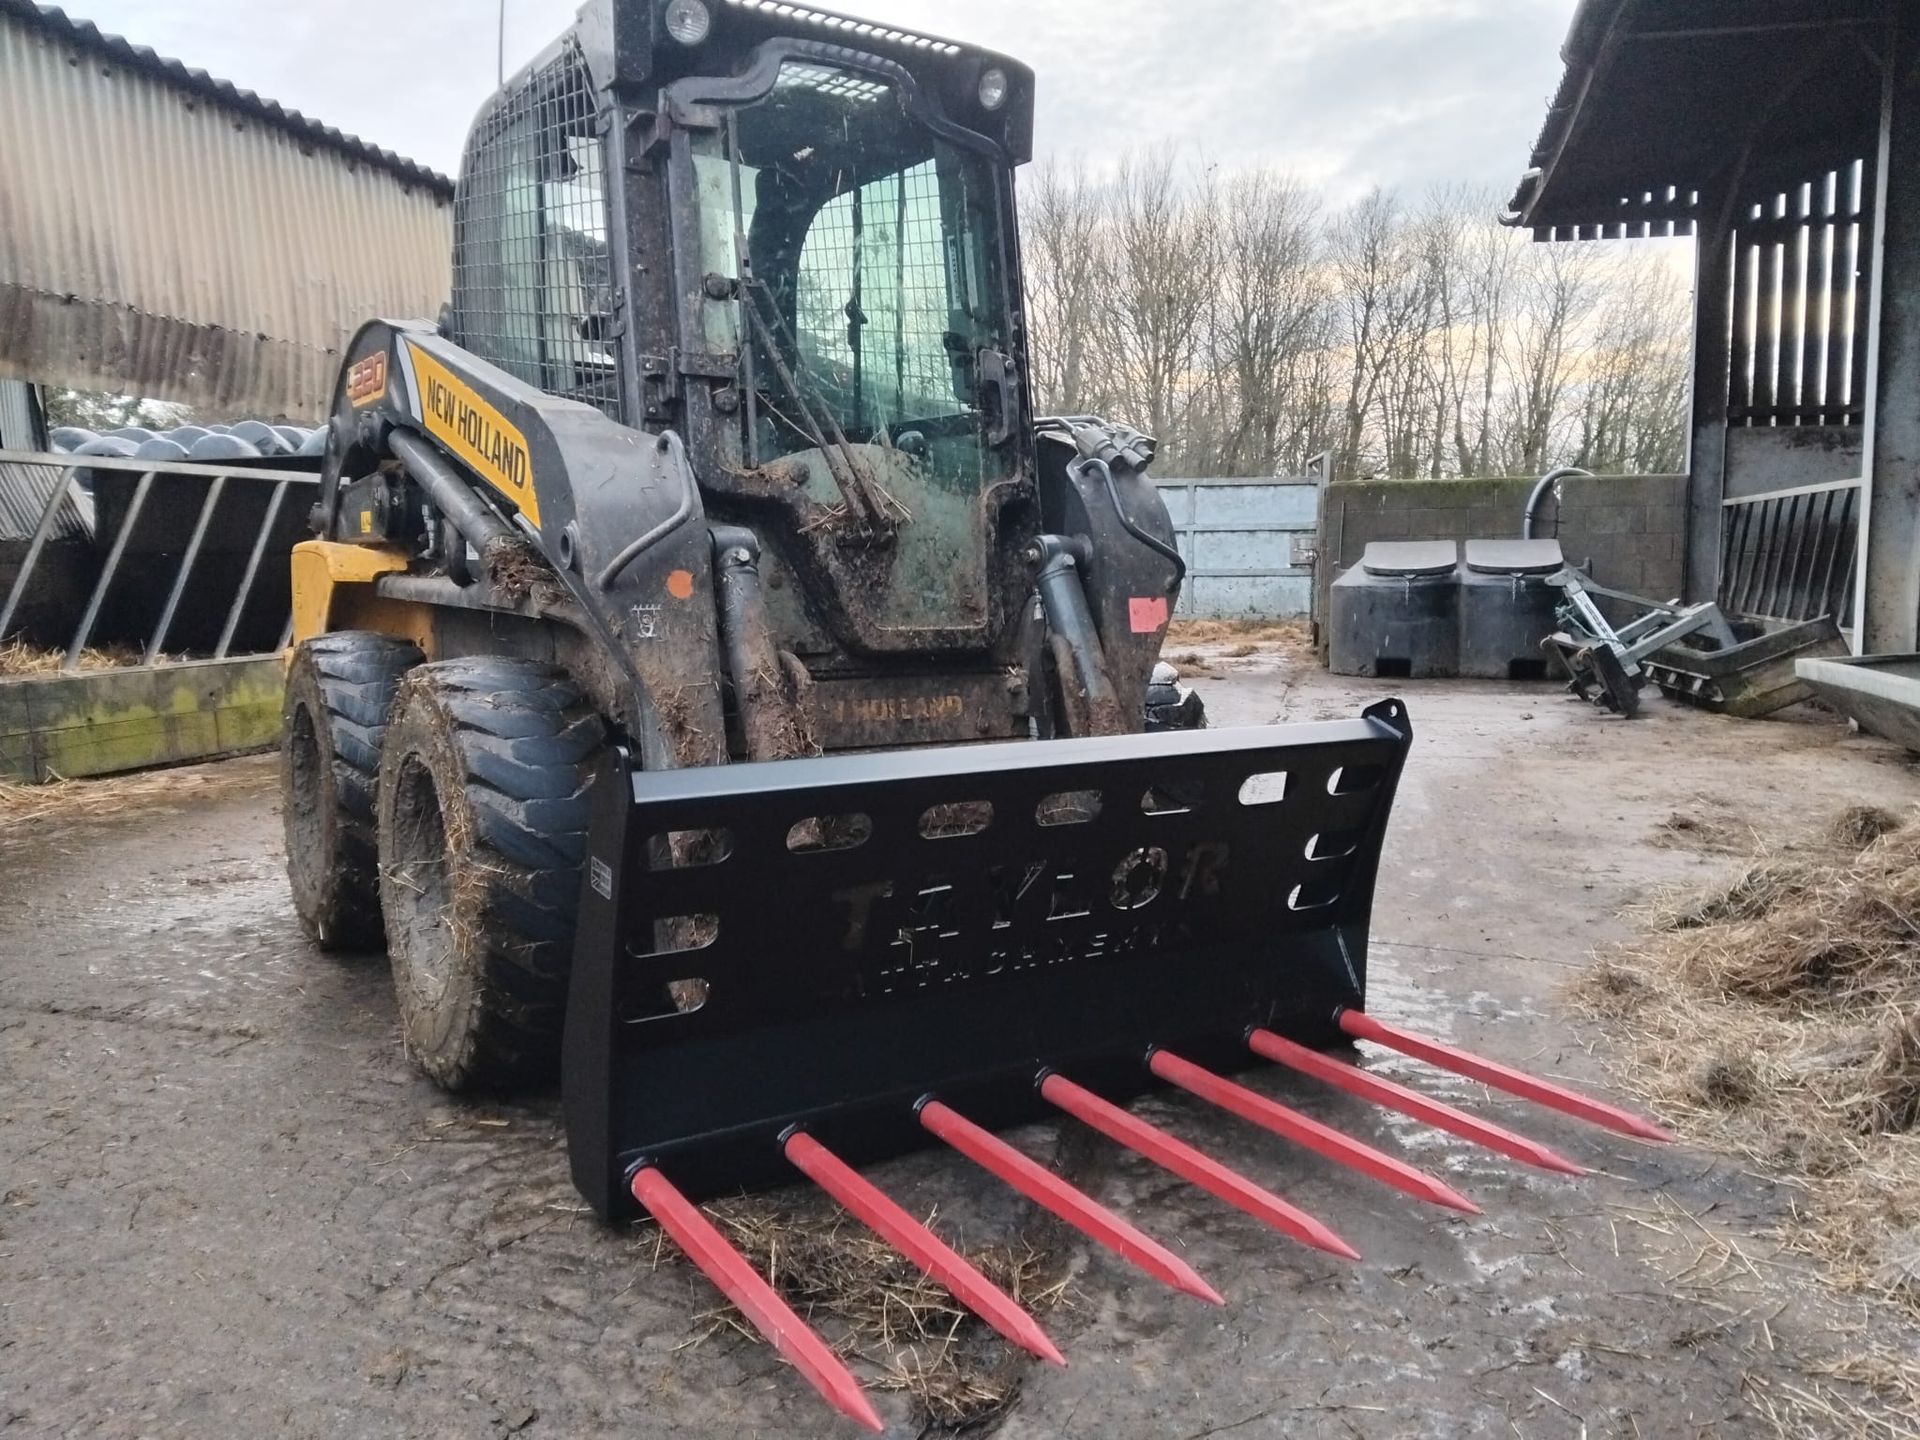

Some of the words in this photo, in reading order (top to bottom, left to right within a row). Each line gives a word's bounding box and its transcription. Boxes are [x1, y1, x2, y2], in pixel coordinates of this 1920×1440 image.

[347, 352, 387, 402] L220
[427, 375, 456, 429] NEW
[457, 400, 526, 489] HOLLAND
[831, 842, 1231, 950] TAYLOR
[838, 918, 1193, 998] TTACHMENT
